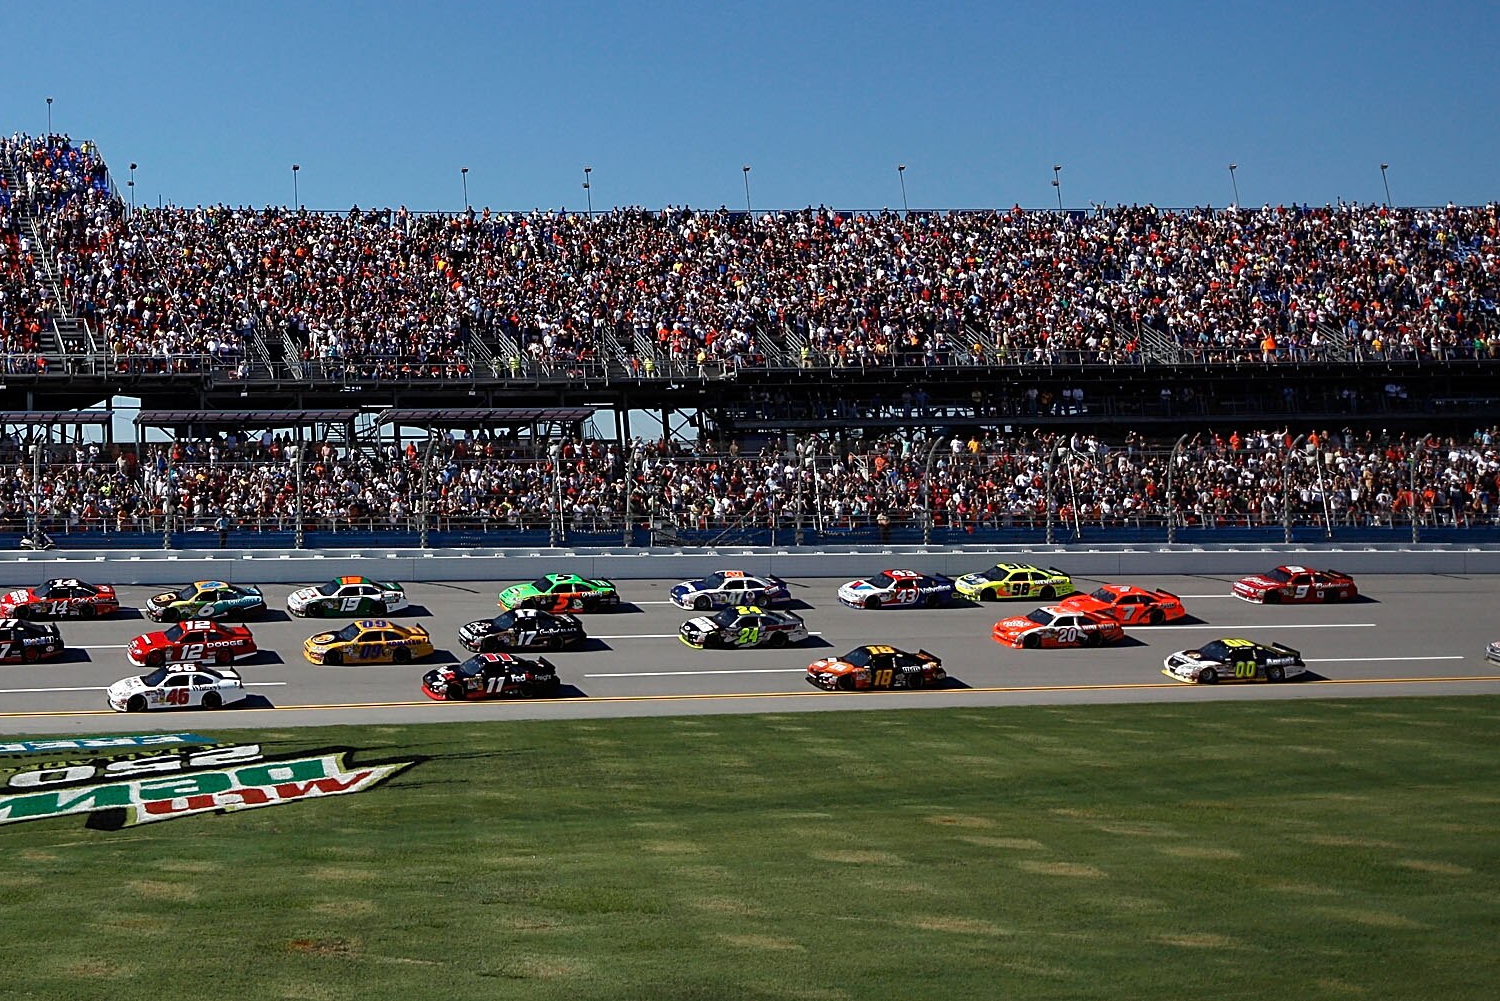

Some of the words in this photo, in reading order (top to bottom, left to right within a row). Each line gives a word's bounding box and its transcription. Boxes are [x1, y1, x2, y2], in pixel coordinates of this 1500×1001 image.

[53, 579, 78, 587] 14
[919, 585, 951, 594] Valvoline
[1012, 582, 1030, 596] 98
[727, 591, 744, 605] 47
[896, 588, 916, 603] 43
[1294, 585, 1310, 599] 9
[48, 600, 69, 615] 14
[340, 597, 362, 612] 19
[554, 593, 568, 610] 5
[197, 605, 215, 617] 6
[515, 609, 537, 618] 17
[1122, 607, 1136, 620] 7
[185, 620, 210, 630] 12
[517, 630, 537, 646] 17
[739, 627, 759, 643] 24
[1058, 627, 1077, 643] 20
[207, 640, 243, 648] DODGE
[387, 639, 421, 648] KOMATSU
[866, 646, 895, 654] 18
[1221, 639, 1255, 647] 00
[180, 643, 204, 660] 12
[361, 644, 380, 659] 09
[168, 663, 197, 672] 46
[1235, 660, 1256, 678] 00
[486, 676, 505, 693] 11
[874, 669, 893, 686] 18
[166, 688, 190, 705] 46
[8, 745, 263, 787] 250
[144, 771, 373, 815] Mtn
